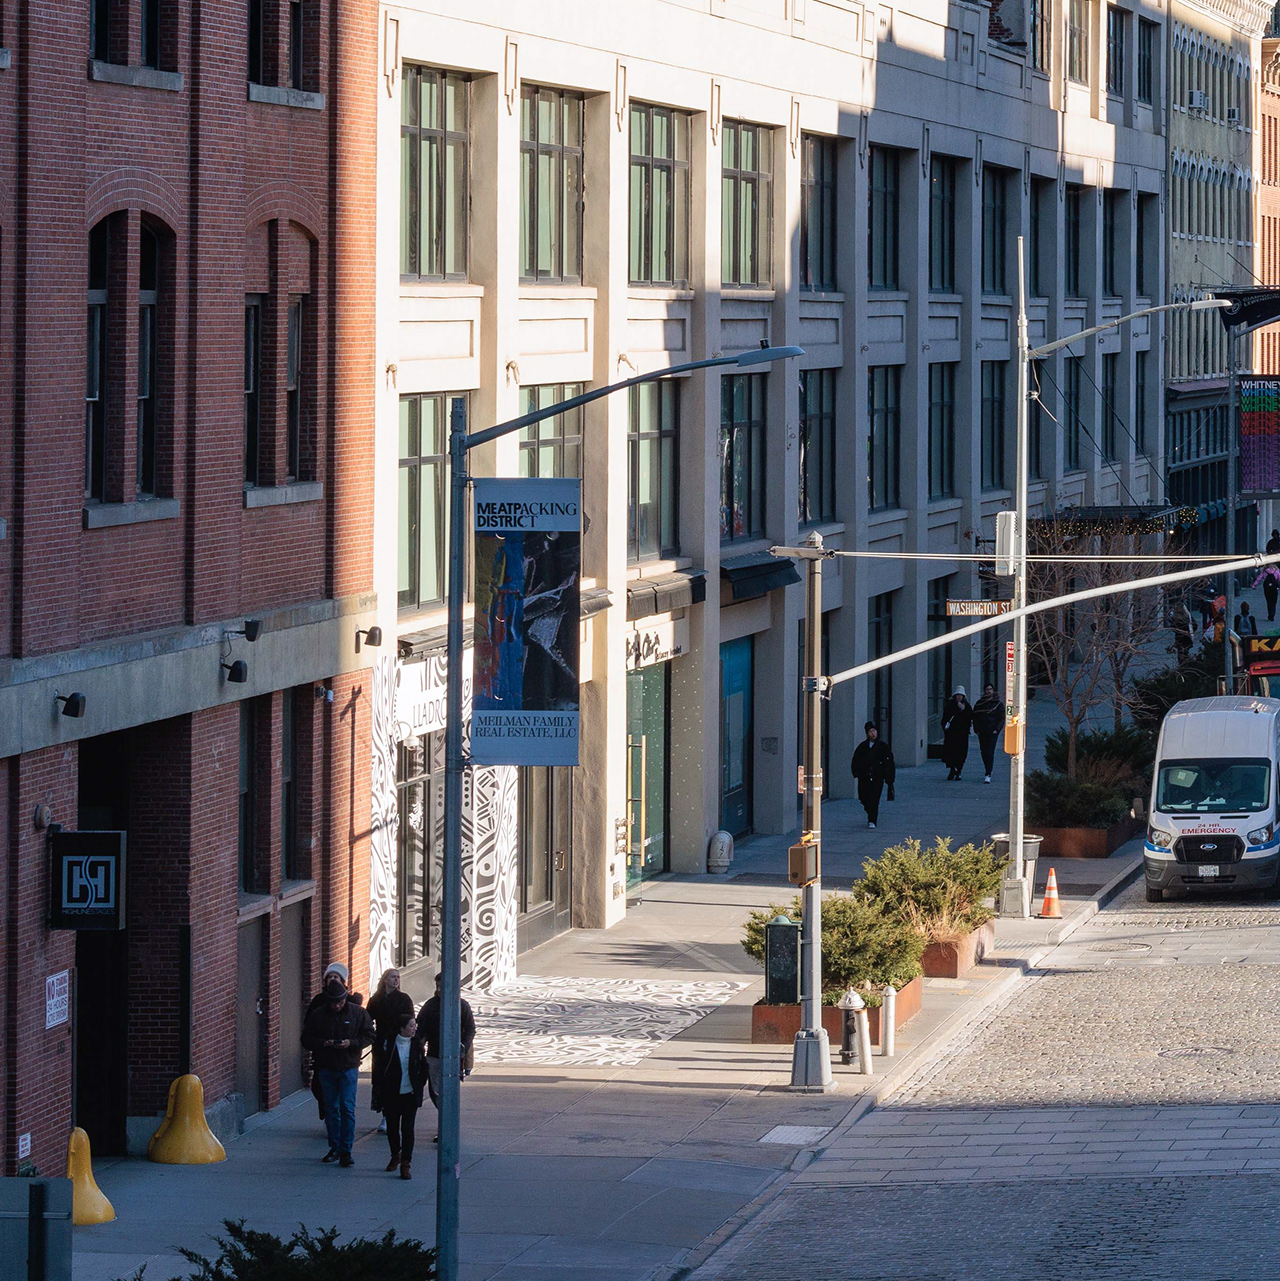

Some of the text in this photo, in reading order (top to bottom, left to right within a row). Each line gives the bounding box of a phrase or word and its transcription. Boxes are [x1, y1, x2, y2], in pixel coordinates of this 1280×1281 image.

[476, 502, 577, 515] MEATPACKING
[477, 515, 538, 528] DISTRICT
[950, 602, 1010, 614] WASHINGTON ST
[477, 716, 575, 726] MEILMAN FAMILY
[475, 727, 576, 739] REAL ESTATE, LLC
